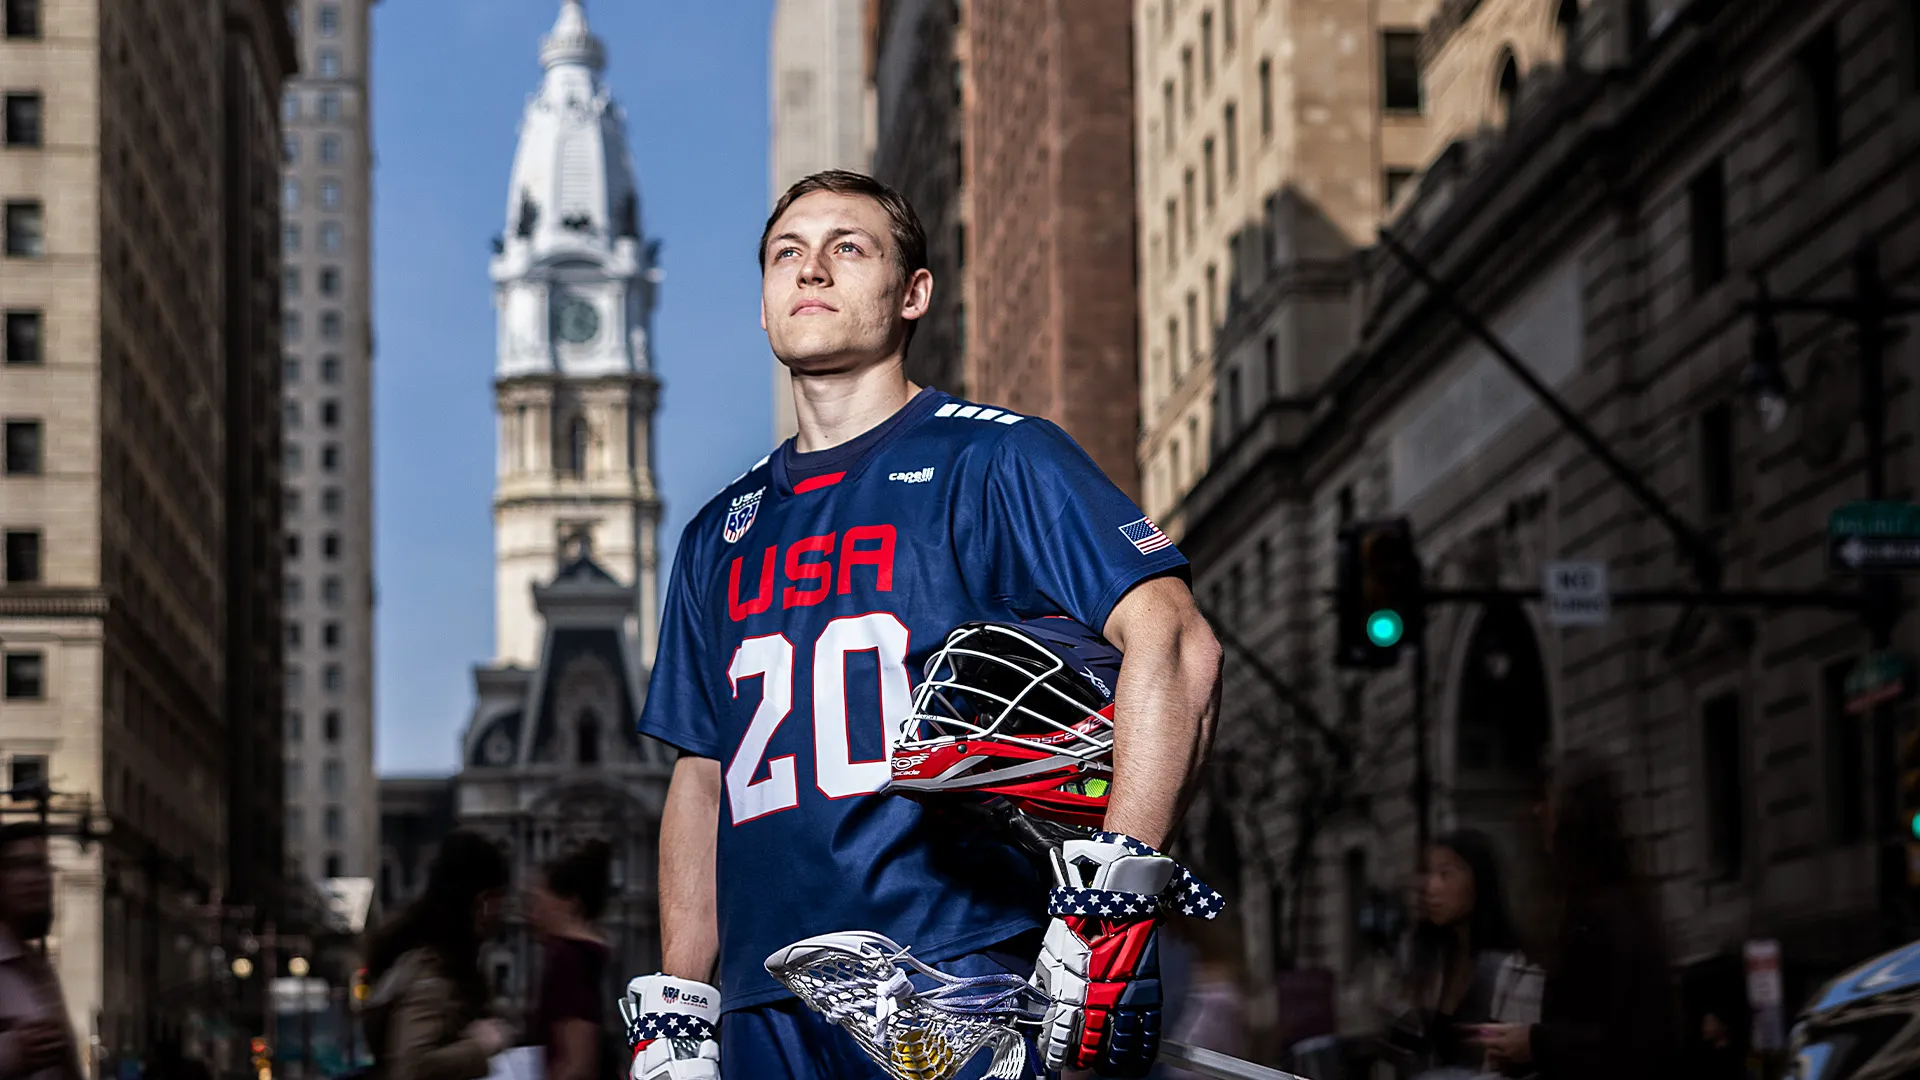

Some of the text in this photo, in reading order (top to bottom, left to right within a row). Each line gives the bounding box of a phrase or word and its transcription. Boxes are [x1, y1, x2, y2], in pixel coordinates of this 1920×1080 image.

[888, 467, 935, 482] capelli
[731, 489, 763, 506] USA
[728, 524, 898, 622] USA
[724, 611, 917, 826] 20
[681, 993, 708, 1006] USA
